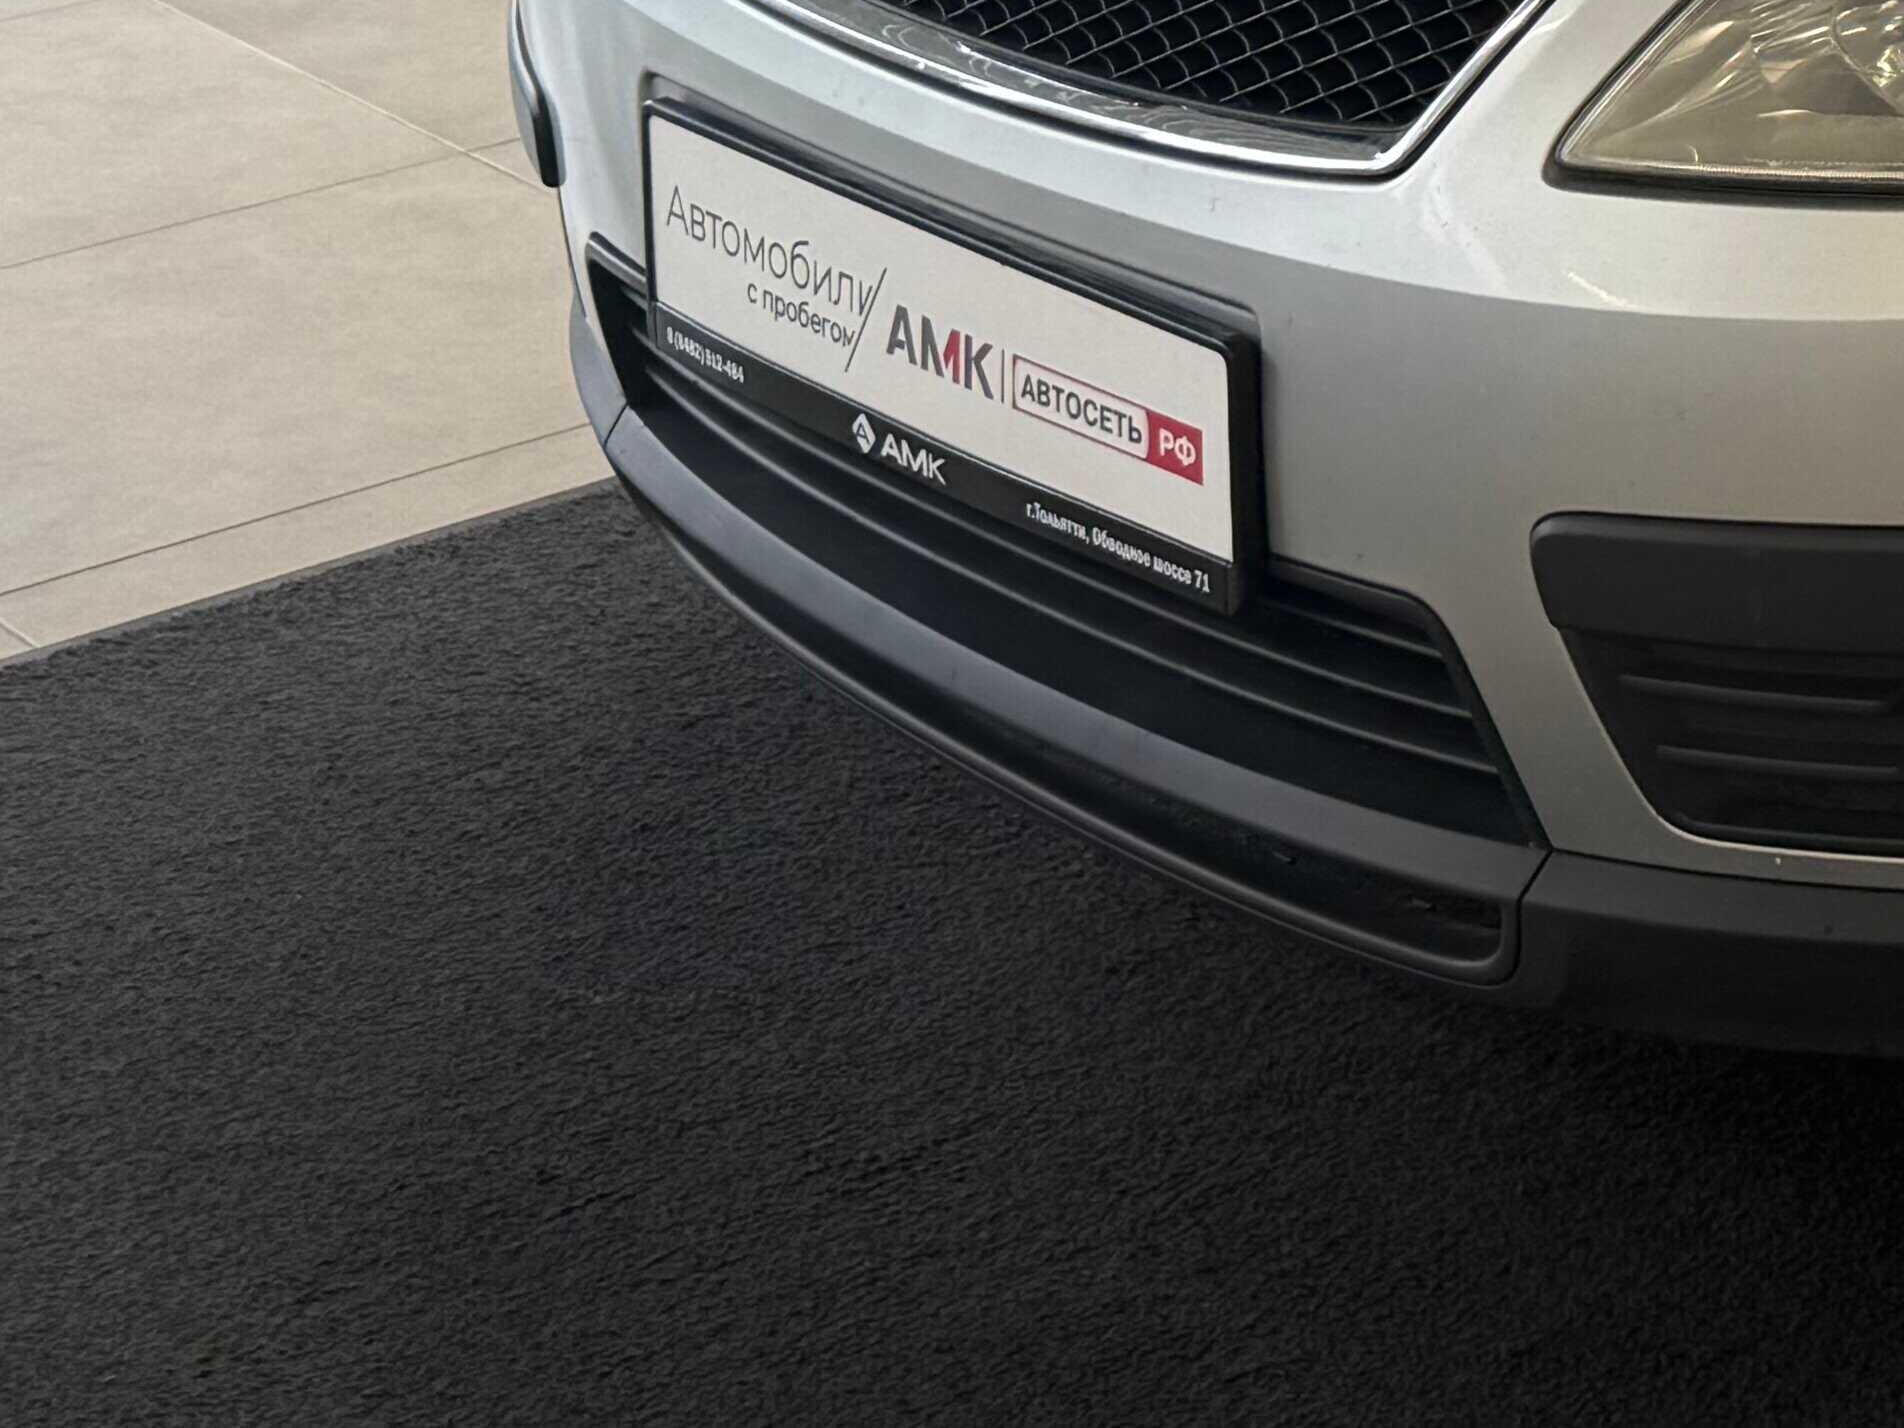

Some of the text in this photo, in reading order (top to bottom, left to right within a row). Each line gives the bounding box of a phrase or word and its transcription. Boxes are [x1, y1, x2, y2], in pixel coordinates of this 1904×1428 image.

[747, 283, 856, 347] с пробегом
[886, 303, 1197, 467] АМК АВТОСЕТЬ РФ
[881, 433, 946, 485] АМК
[1153, 555, 1192, 585] шоссе
[1194, 569, 1210, 593] 71
